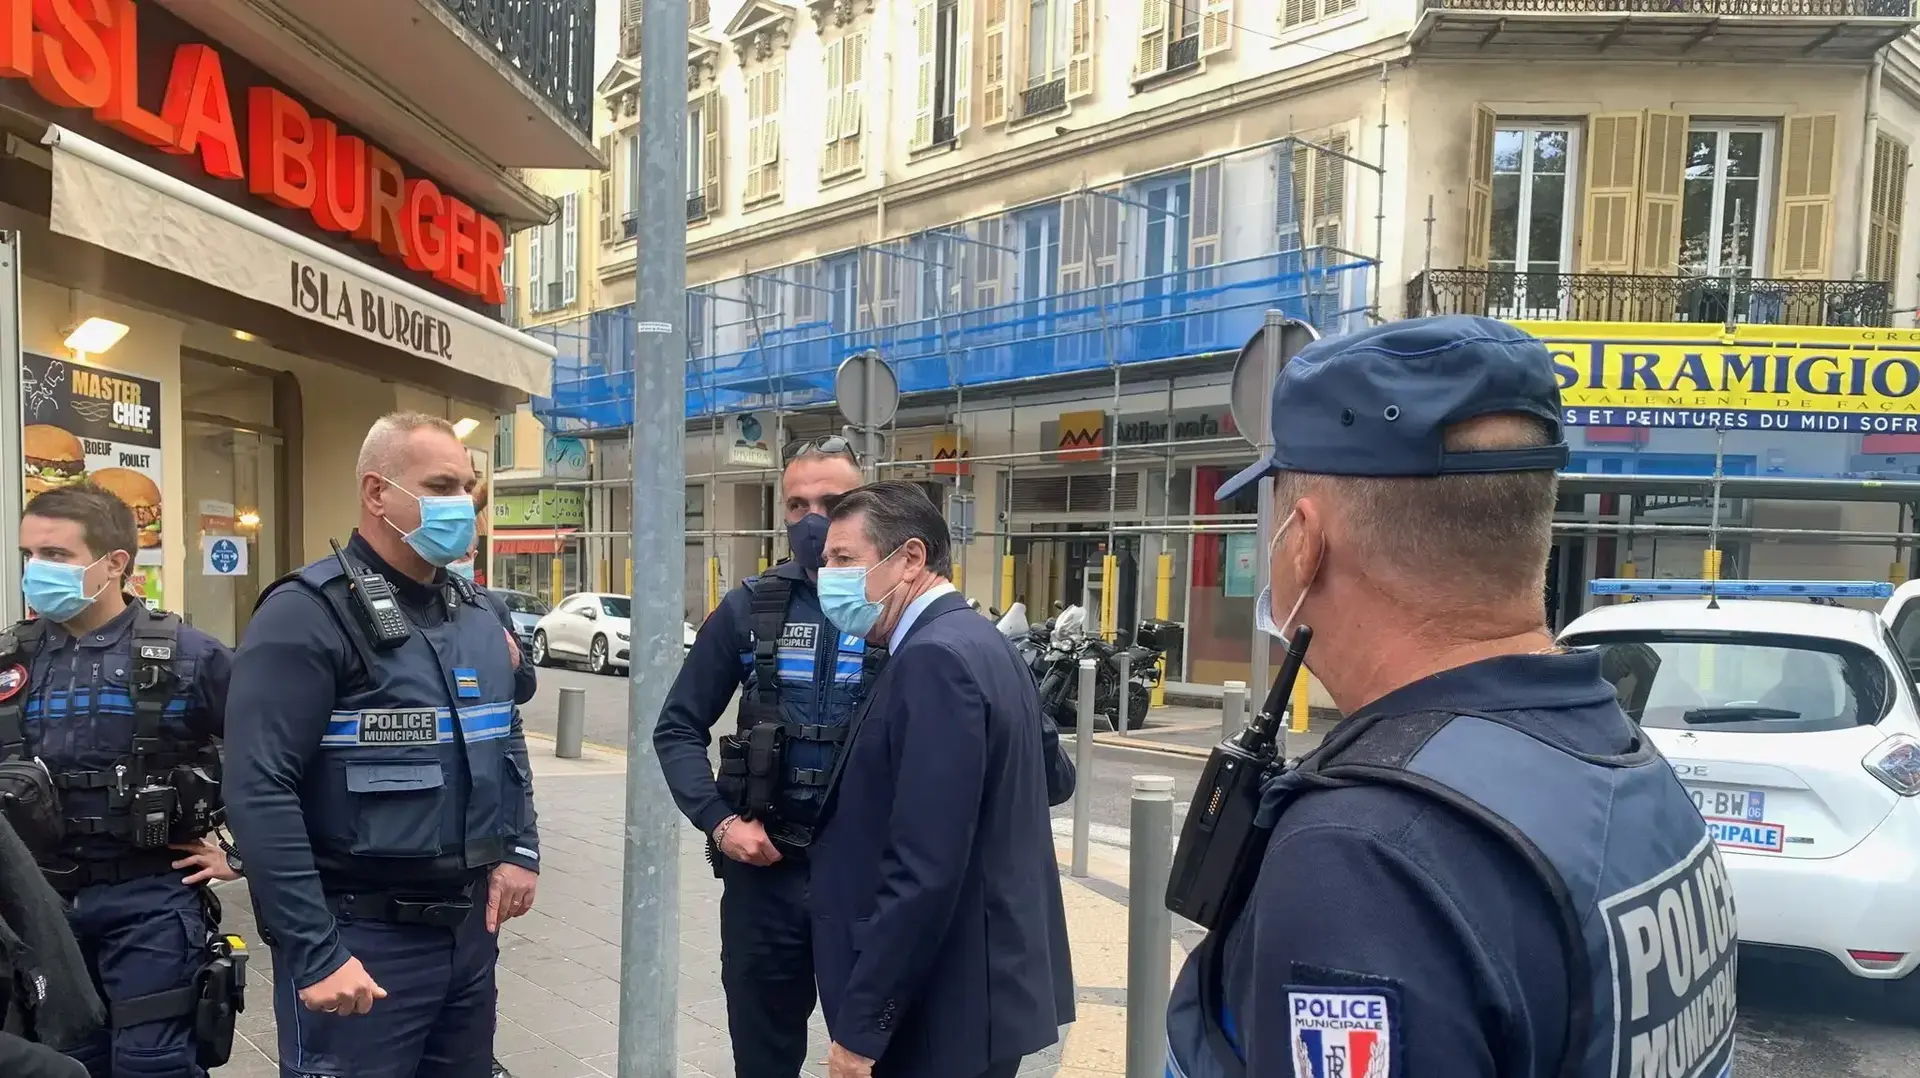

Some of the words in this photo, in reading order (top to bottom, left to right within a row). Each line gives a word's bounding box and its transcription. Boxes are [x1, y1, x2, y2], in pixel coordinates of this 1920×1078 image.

[0, 0, 244, 180] ISLA
[248, 86, 506, 304] BURGER
[291, 260, 355, 326] ISLA
[360, 288, 453, 360] BURGER
[72, 370, 141, 405] MASTER
[113, 401, 151, 429] CHEF
[1566, 409, 1578, 425] S
[1589, 410, 1614, 425] ET
[1626, 411, 1748, 427] PEINTURES
[1760, 413, 1789, 429] DU
[1801, 415, 1848, 431] MIDI
[84, 439, 112, 456] BOEUF
[119, 452, 150, 468] POULET
[782, 626, 814, 638] LICE
[364, 713, 432, 729] POLICE
[364, 729, 432, 741] MUNICIPALE
[1673, 764, 1709, 776] OE
[1747, 807, 1761, 818] 06
[1709, 824, 1776, 845] CIPALE
[1294, 998, 1383, 1019] POLICE
[1295, 1018, 1383, 1030] MUNICIPALE
